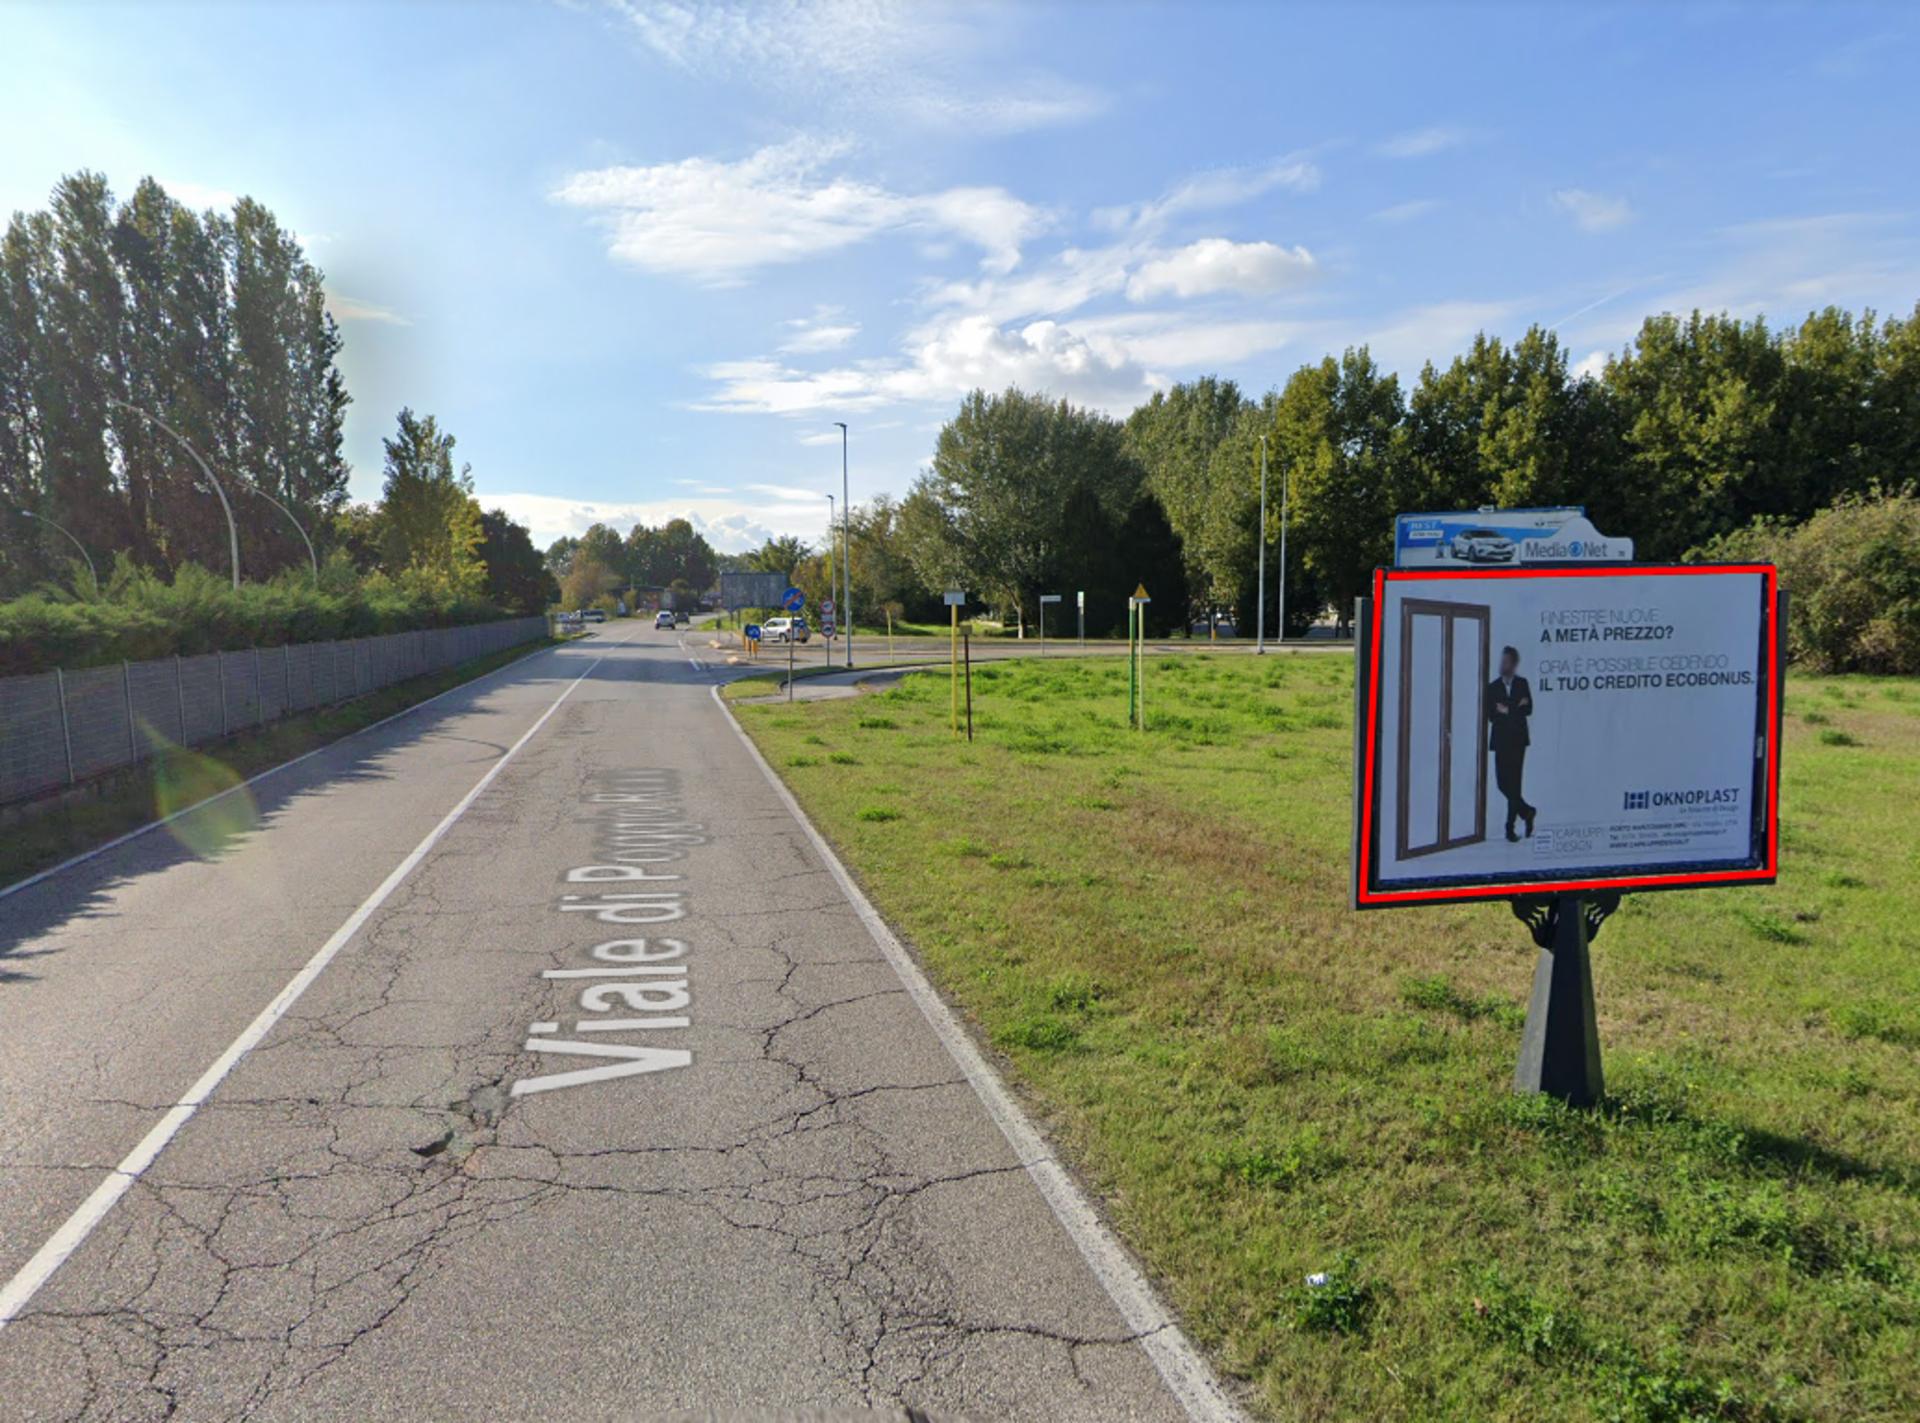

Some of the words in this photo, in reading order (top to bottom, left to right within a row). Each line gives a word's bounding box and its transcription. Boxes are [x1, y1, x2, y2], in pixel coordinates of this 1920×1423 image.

[1525, 541, 1567, 558] Media
[1583, 541, 1608, 557] Net
[1540, 609, 1607, 626] FINESTRE
[1609, 608, 1660, 625] NUOVE
[1540, 629, 1551, 643] A
[1555, 624, 1600, 642] METÀ
[1603, 625, 1674, 641] PREZZO?
[1539, 659, 1570, 674] ORA
[1574, 656, 1583, 674] È
[1539, 678, 1553, 691] IL
[1557, 676, 1590, 691] TUO
[1593, 673, 1662, 689] CREDITO
[1666, 671, 1755, 687] ECOBONUS.
[1652, 788, 1740, 806] OKNOPLAST
